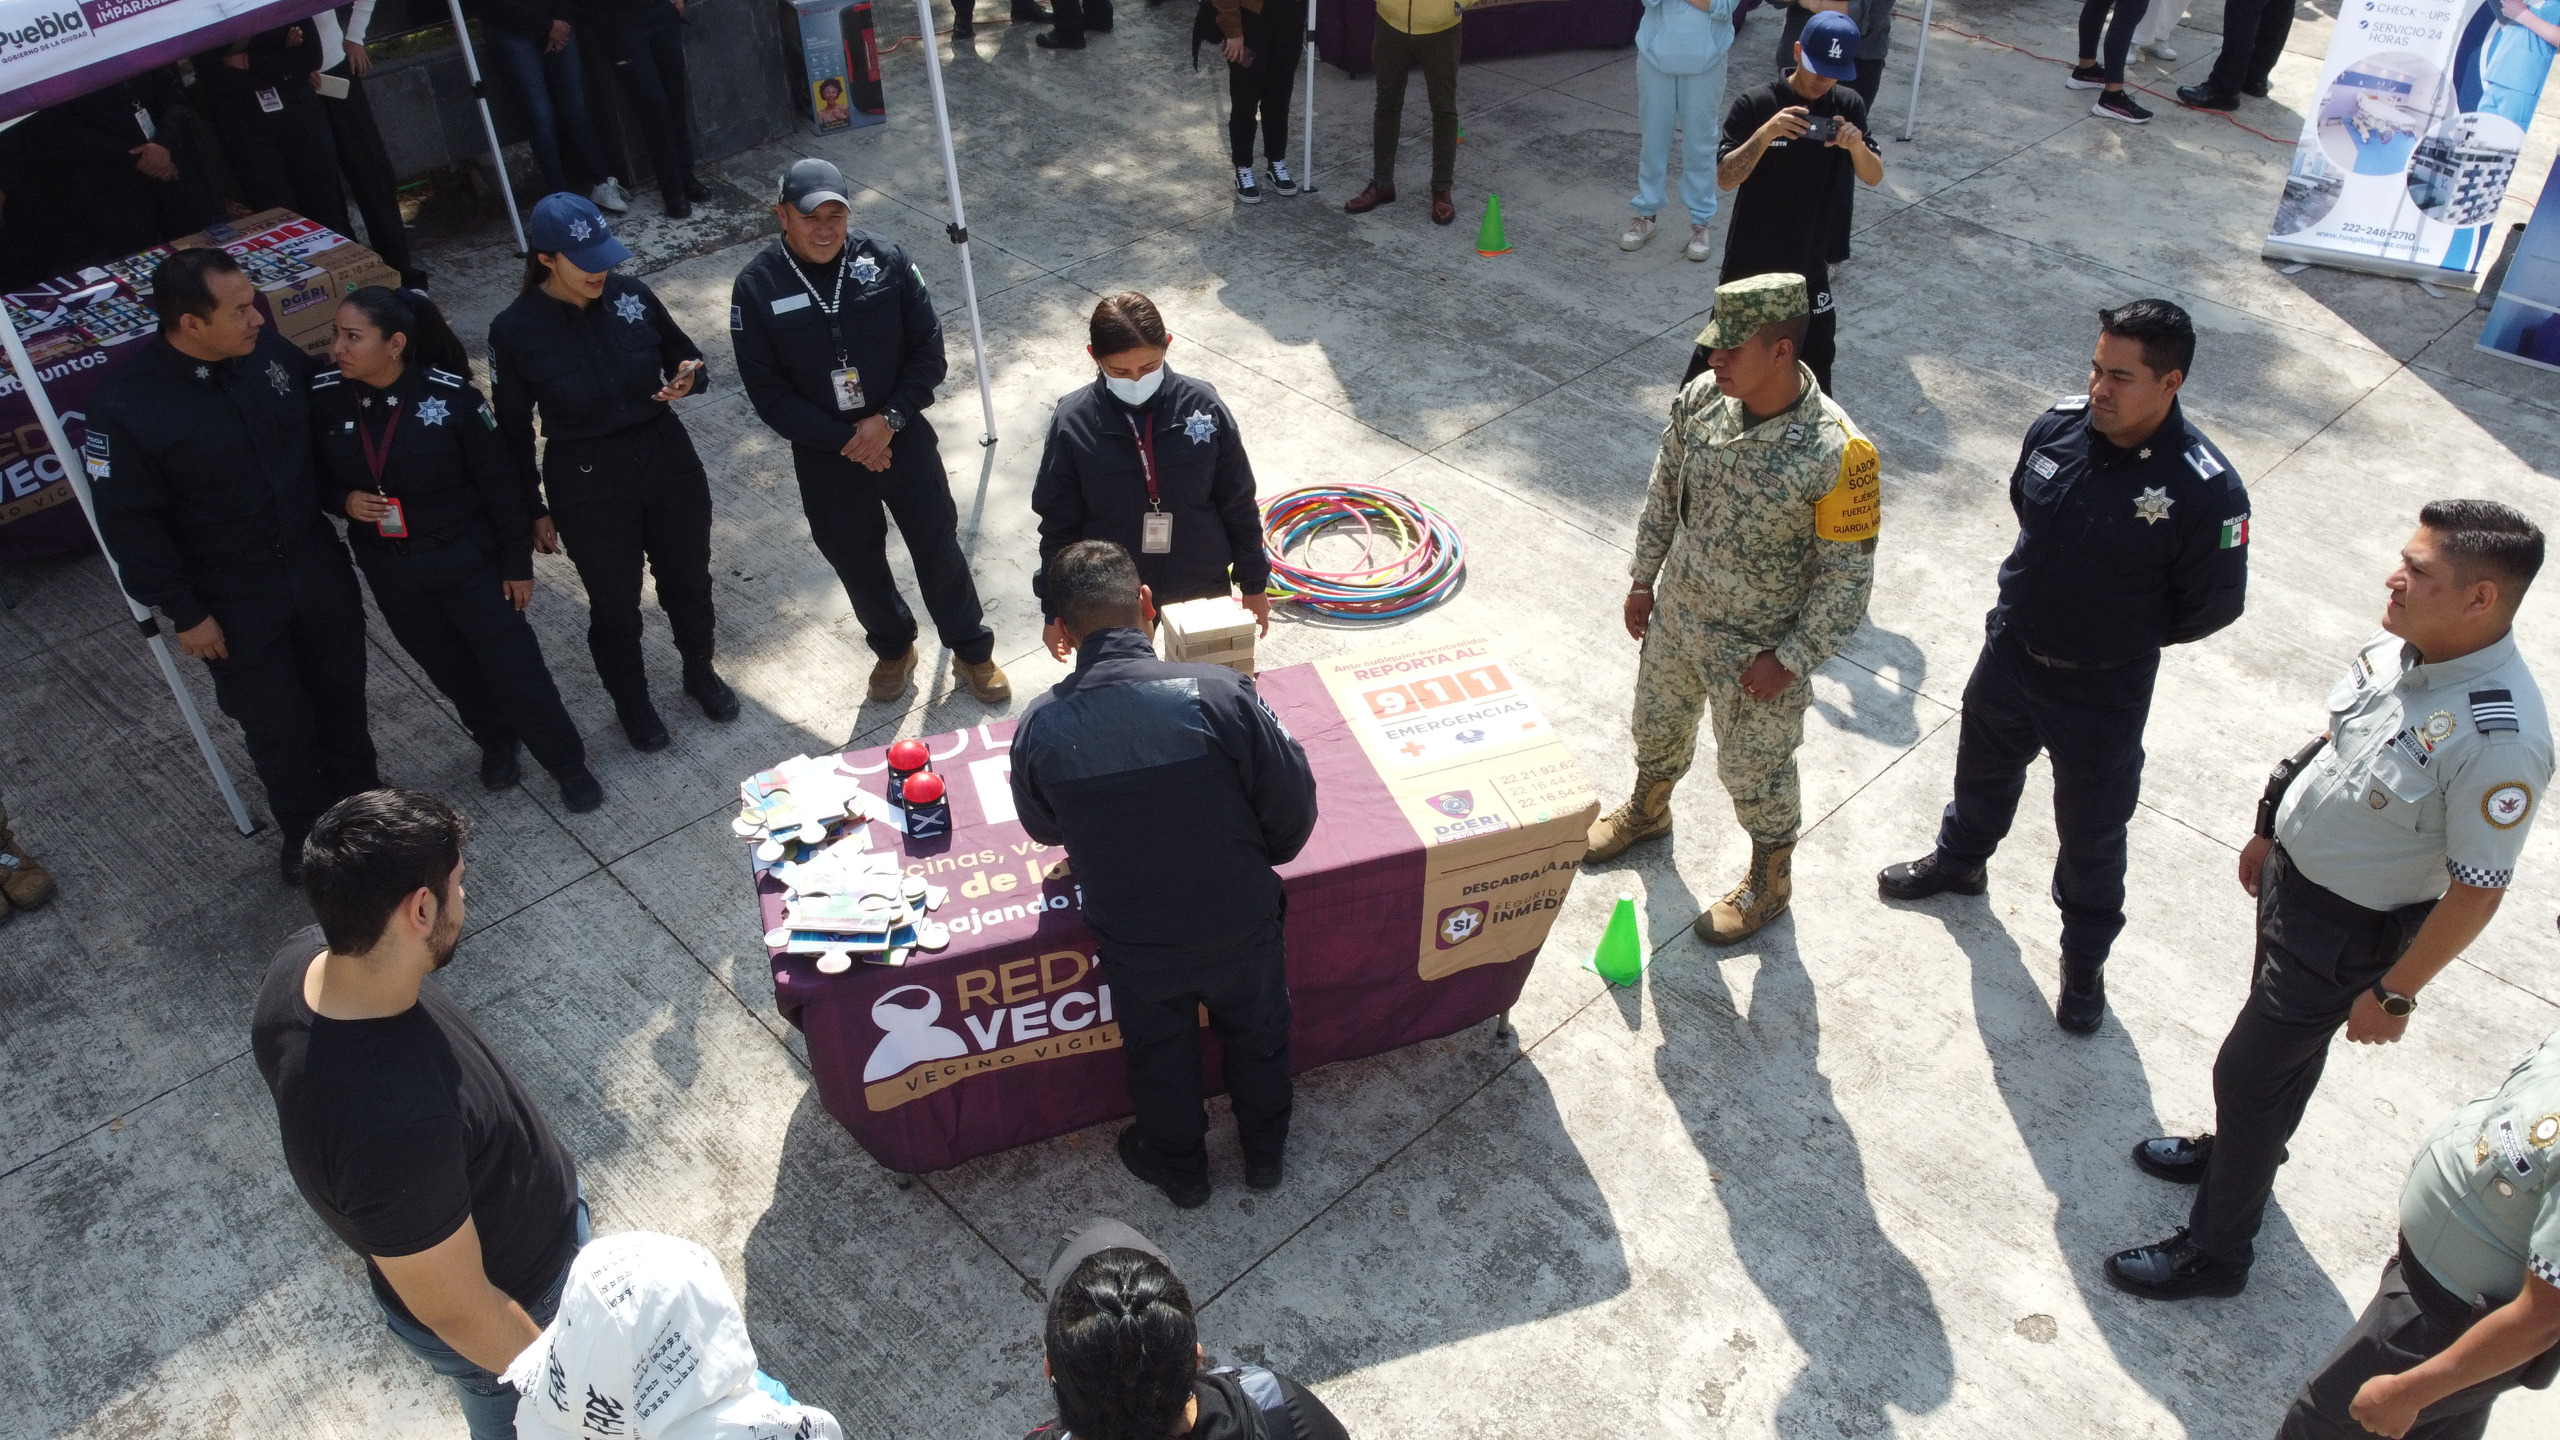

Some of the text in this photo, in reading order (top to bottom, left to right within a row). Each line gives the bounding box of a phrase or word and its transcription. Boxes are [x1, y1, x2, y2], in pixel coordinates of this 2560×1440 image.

[2377, 3, 2418, 17] CHECK
[2429, 10, 2451, 22] UPS
[2368, 33, 2410, 47] HORAS
[2372, 21, 2443, 40] SERVICIO 24
[1, 30, 88, 64] GOBIERNO DE LA CIUDAD
[1828, 38, 1843, 59] LA
[2316, 230, 2430, 254] www.hospitallapaz.com.mx
[2342, 223, 2416, 241] 222-248-2710
[281, 285, 325, 308] DGERI
[1848, 457, 1876, 477] LABOR
[1849, 471, 1879, 490] SOCIAL
[1842, 505, 1872, 518] FUERZA
[2223, 512, 2248, 527] MÉXICO
[1833, 523, 1870, 534] GUARDIA
[1333, 662, 1361, 674] Ante
[1363, 650, 1417, 668] cualquier
[1353, 646, 1488, 682] REPORTA AL:
[1376, 669, 1498, 714] 911
[1385, 701, 1529, 741] EMERGENCIAS
[1433, 813, 1502, 836] DGERI
[1438, 823, 1509, 845] RESPUESTA INMEDIATA
[961, 859, 1072, 899] de la
[1462, 869, 1540, 896] DESCARGA
[1540, 861, 1557, 875] LA
[1453, 918, 1471, 932] SI
[955, 950, 1089, 1011] RED
[905, 1031, 1122, 1093] VECINO VIGIL
[2501, 1128, 2518, 1166] NACIONAL
[2508, 1129, 2521, 1161] GUARDIA
